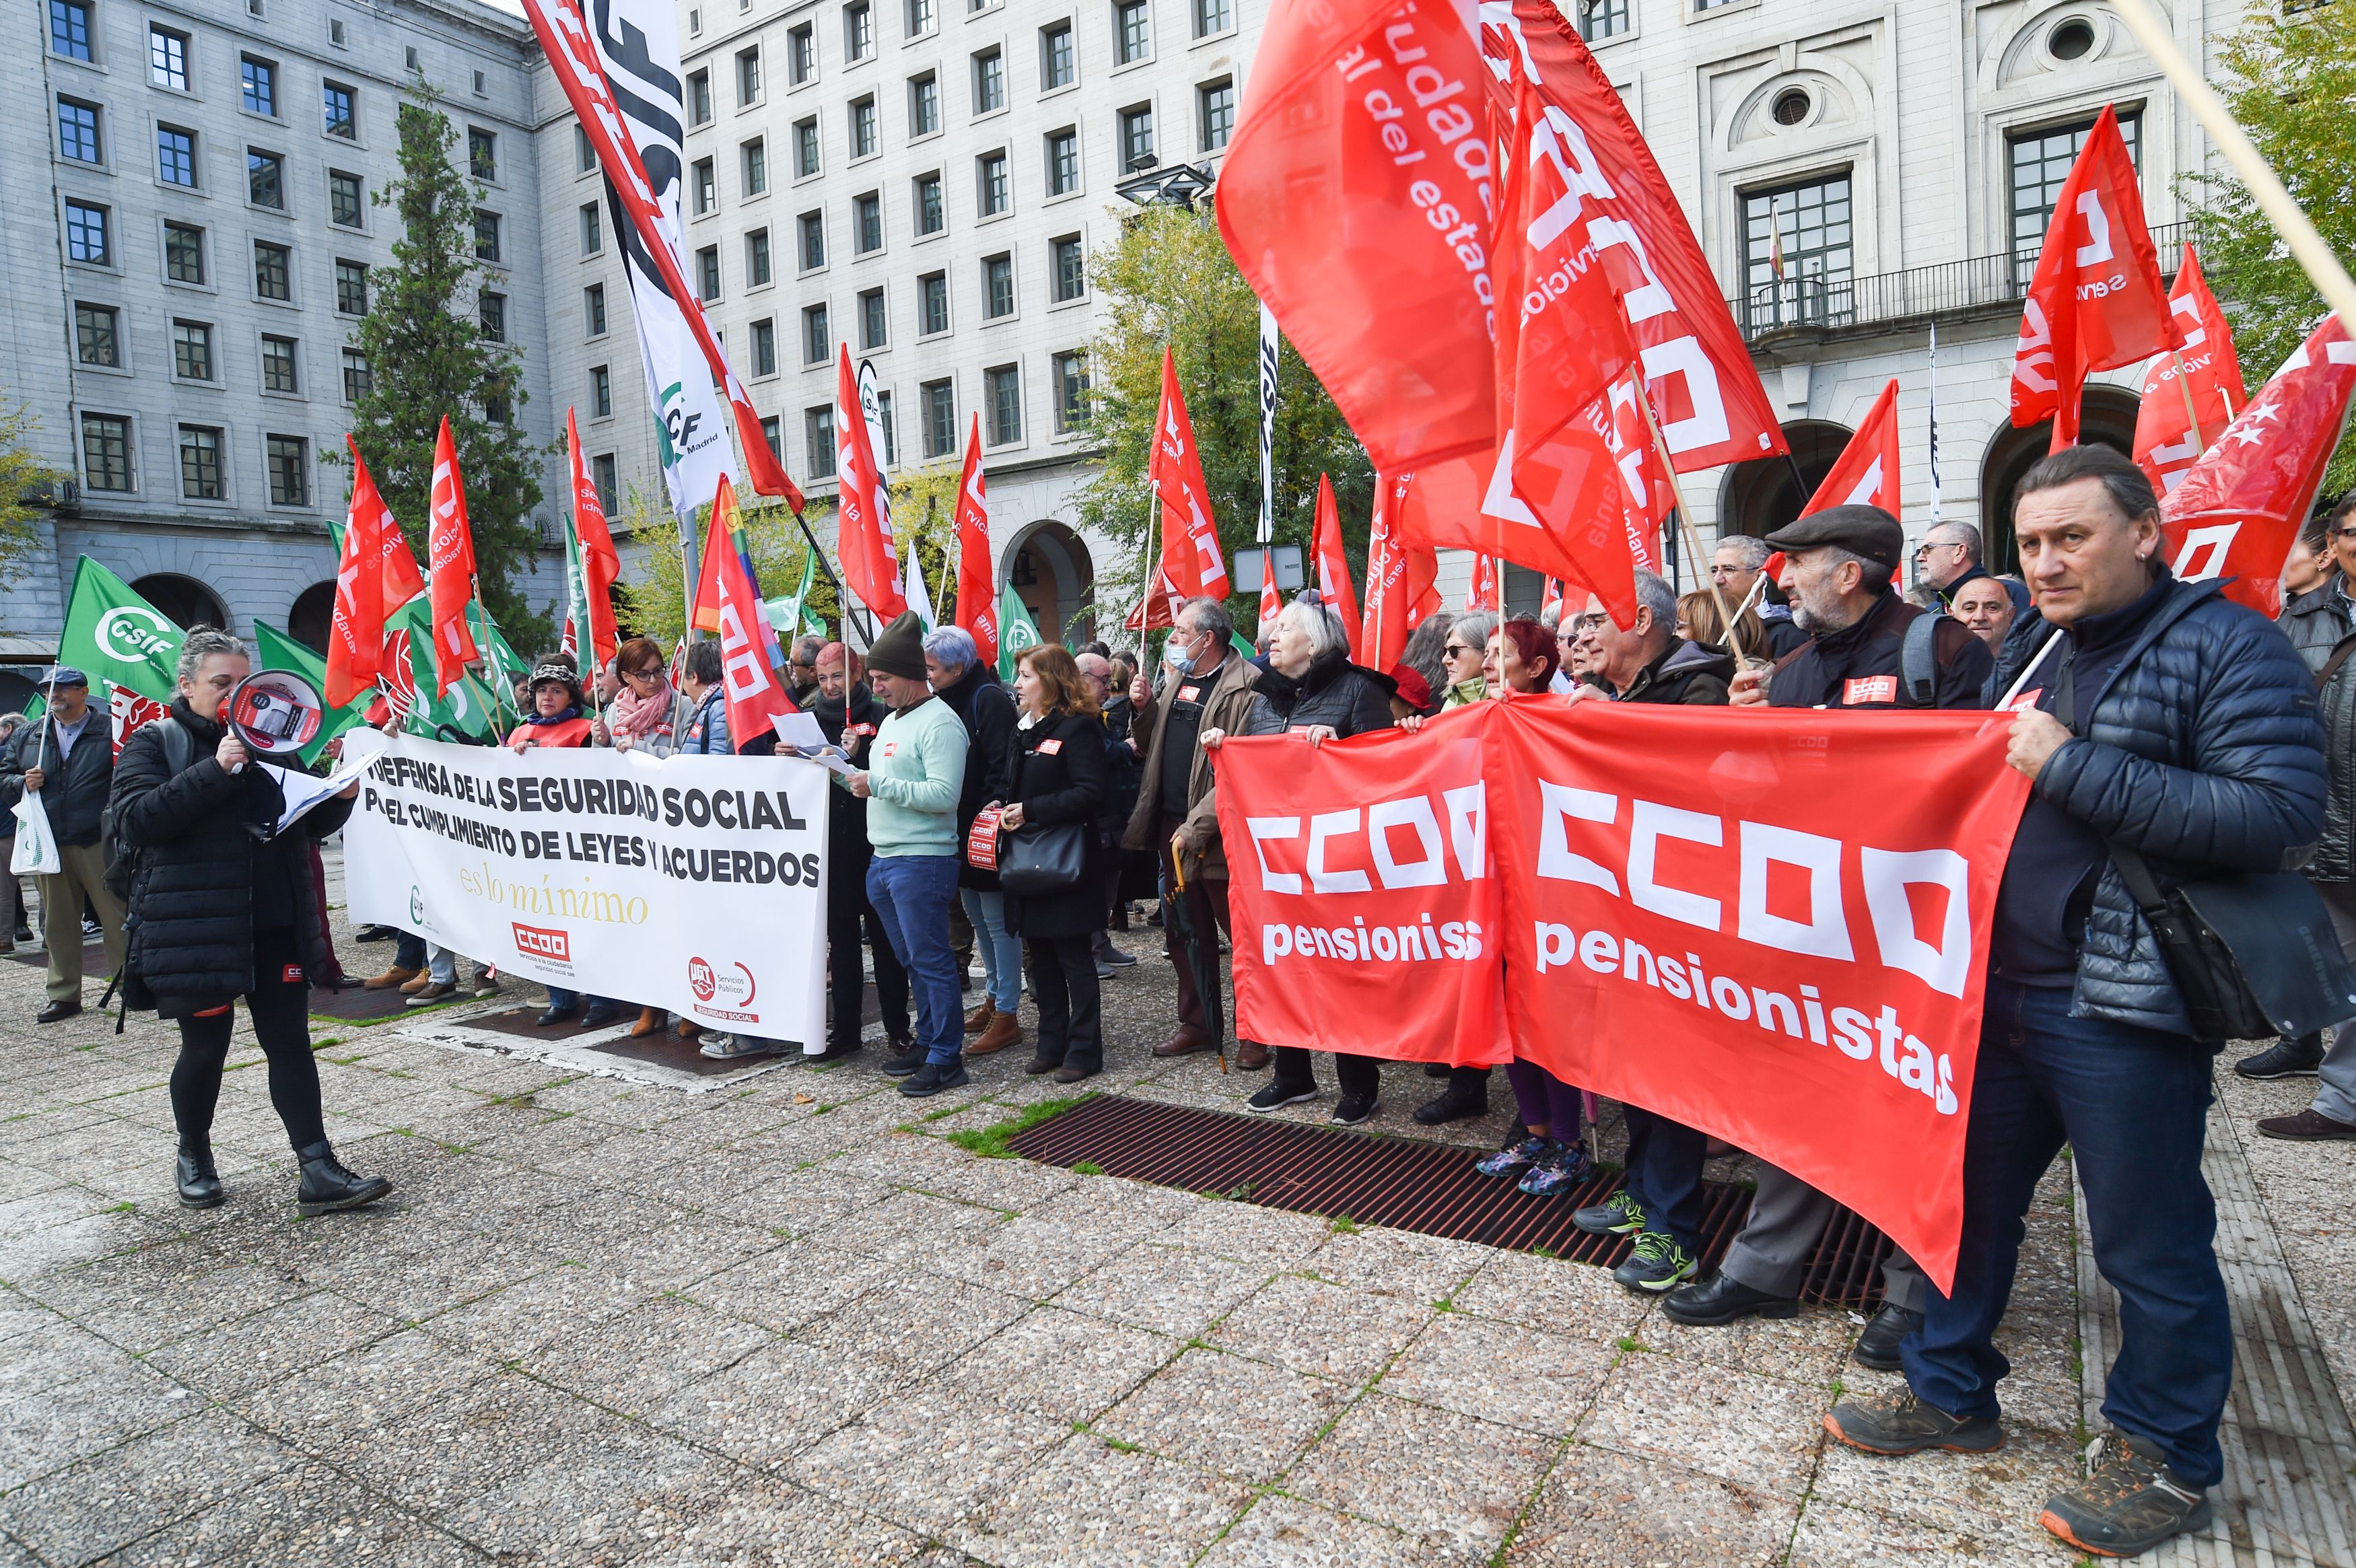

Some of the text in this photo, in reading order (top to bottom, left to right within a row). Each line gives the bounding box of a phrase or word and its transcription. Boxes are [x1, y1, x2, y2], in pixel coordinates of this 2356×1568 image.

[687, 433, 718, 454] Madrid
[111, 620, 174, 655] CSIF
[1852, 682, 1889, 694] CCOO
[454, 773, 475, 804] DE
[476, 777, 497, 809] LA
[497, 777, 658, 822] SEGURIDAD
[662, 787, 806, 830] SOCIAL
[386, 798, 407, 826] EL
[408, 804, 516, 857] CUMPLIMIENTO
[520, 830, 561, 860] DE
[566, 831, 646, 867] LEYES
[648, 839, 657, 871] Y
[662, 844, 820, 888] ACUERDOS
[971, 841, 992, 850] CCOO
[971, 855, 992, 863] CCOO
[460, 861, 649, 925] es lo mínimo
[1537, 777, 1972, 1000] CCOO
[516, 928, 567, 956] CCOO
[717, 974, 744, 985] Servicios
[718, 984, 744, 994] Públicos
[696, 1005, 754, 1022] SEGURIDAD SOCIAL
[1535, 920, 1959, 1116] pensionistas
